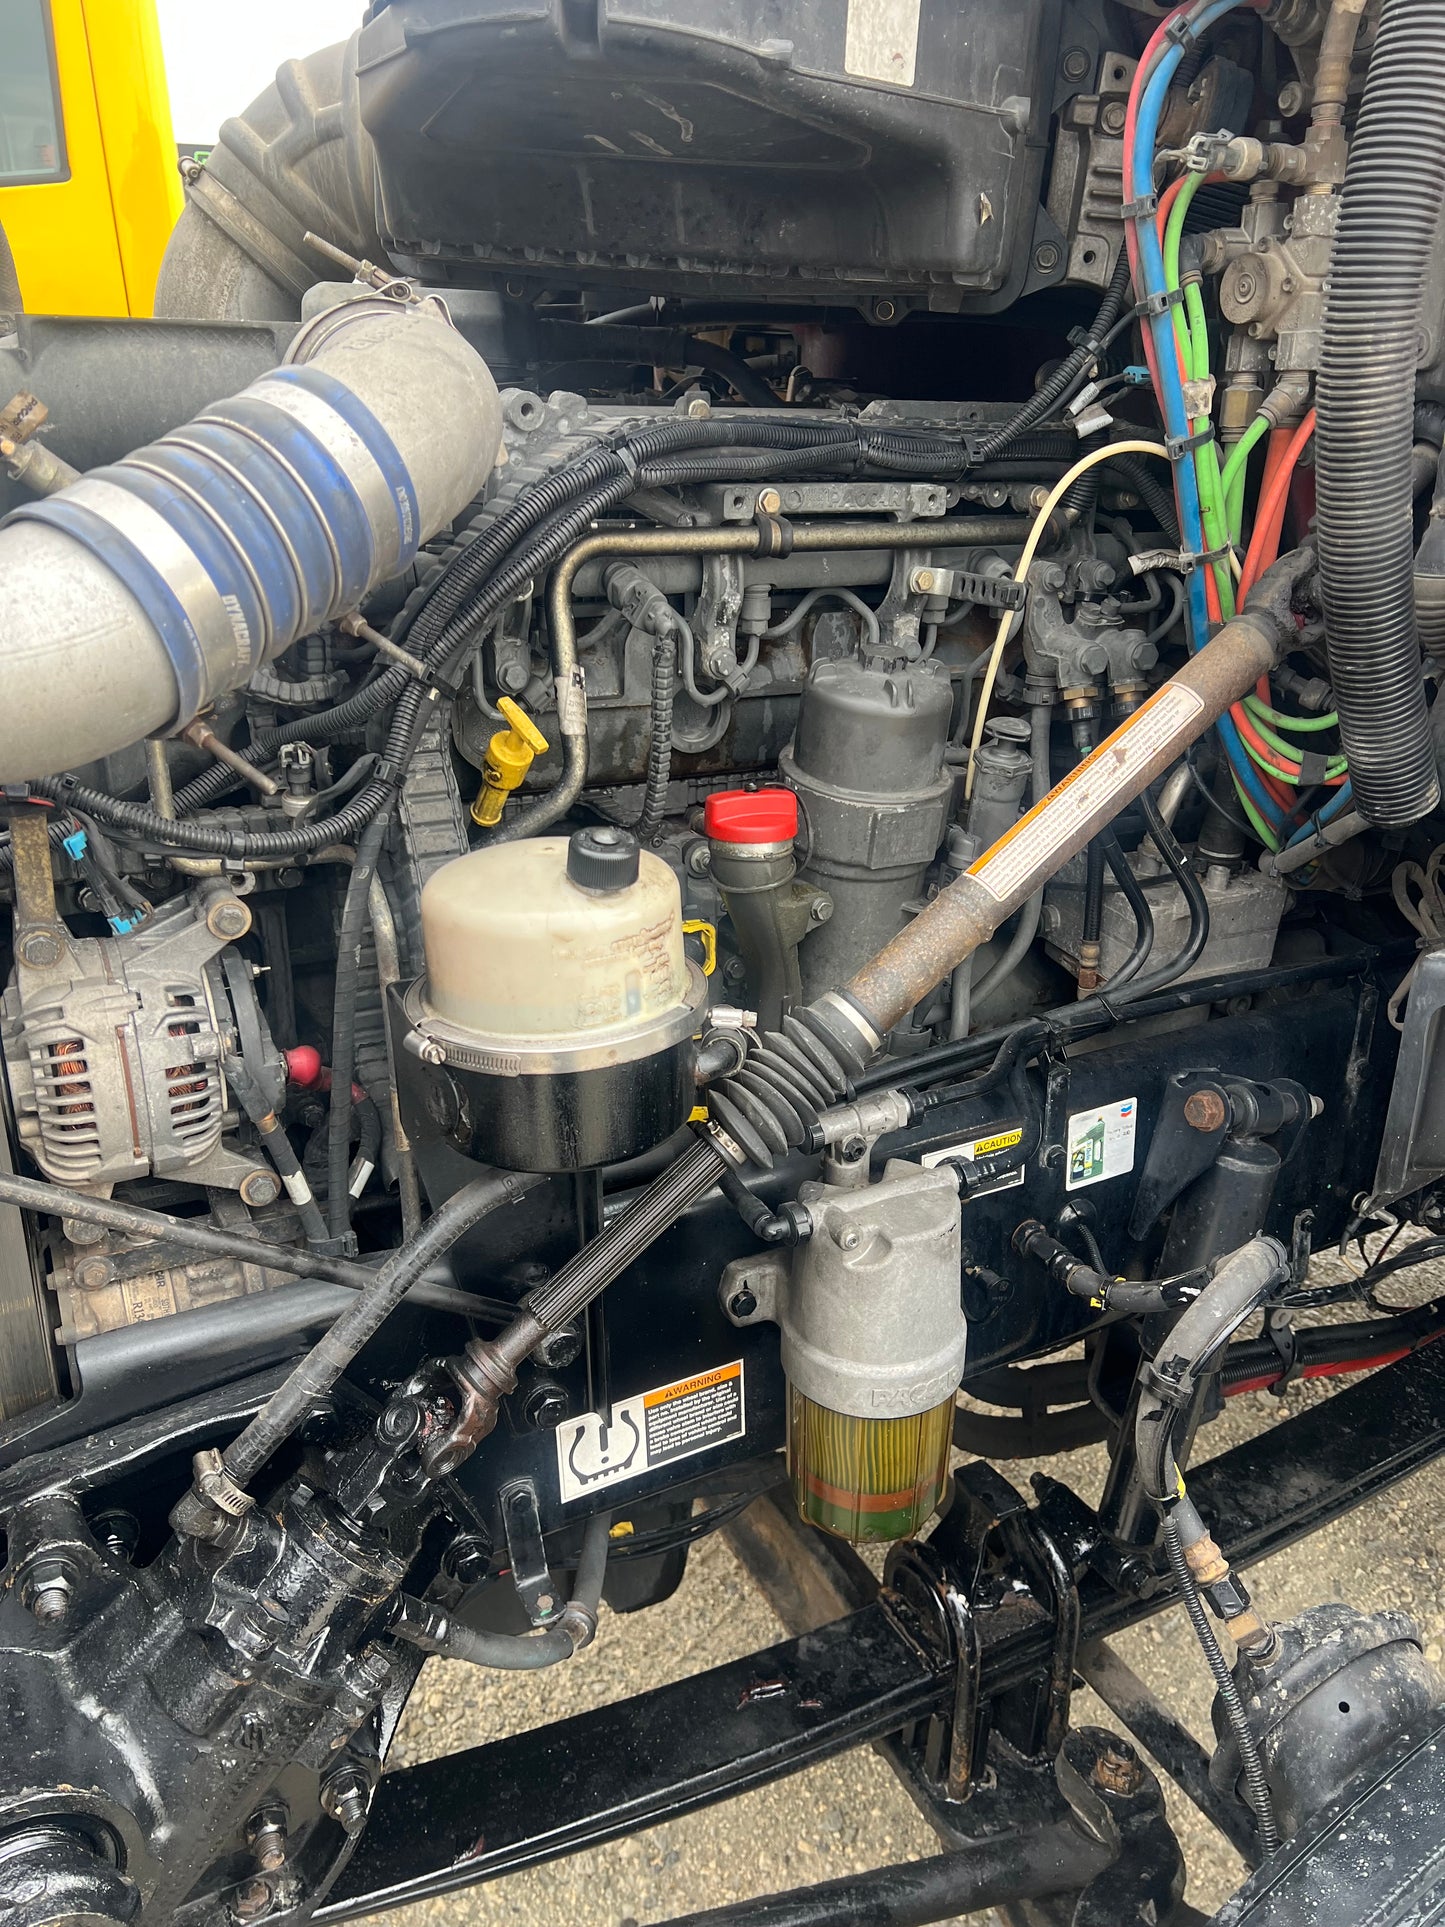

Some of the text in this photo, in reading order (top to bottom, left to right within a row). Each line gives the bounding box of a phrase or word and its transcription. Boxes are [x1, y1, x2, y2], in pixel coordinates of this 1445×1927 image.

[221, 594, 252, 665] DYNACRAFT
[984, 1134, 1023, 1151] CAUTION
[133, 1301, 145, 1320] R13
[674, 1372, 721, 1395] WARNING
[648, 1407, 659, 1416] Use
[660, 1402, 672, 1412] only
[673, 1399, 681, 1407] the
[683, 1393, 698, 1403] wheel
[694, 1398, 701, 1406] by
[702, 1395, 710, 1403] the
